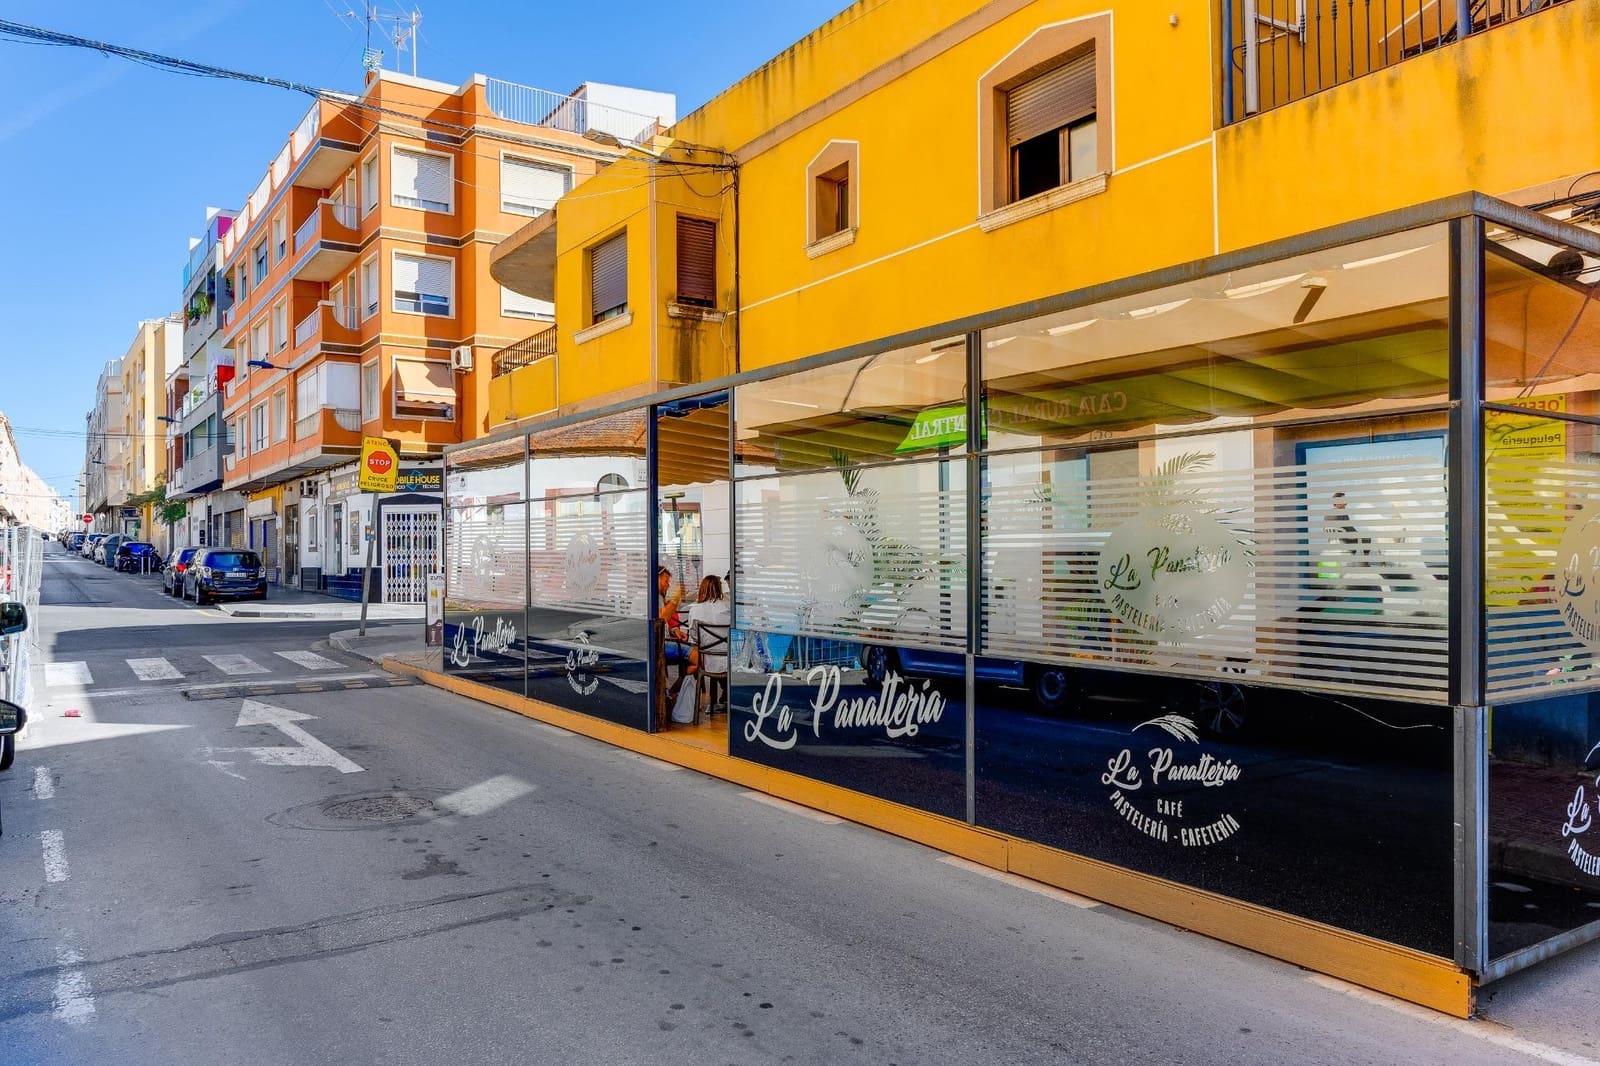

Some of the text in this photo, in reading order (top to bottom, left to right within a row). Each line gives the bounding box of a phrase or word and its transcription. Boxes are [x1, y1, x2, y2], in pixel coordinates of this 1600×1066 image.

[369, 458, 391, 467] STOP
[396, 475, 440, 484] OBILE HOUSE
[1104, 553, 1141, 590] La
[451, 621, 469, 668] La
[744, 674, 798, 750] La
[1101, 749, 1143, 790] La
[1109, 790, 1168, 843] PASTELERÍA
[1181, 813, 1241, 847] CAFETERÍA
[1157, 798, 1183, 818] CAFÉ
[1562, 785, 1592, 837] La
